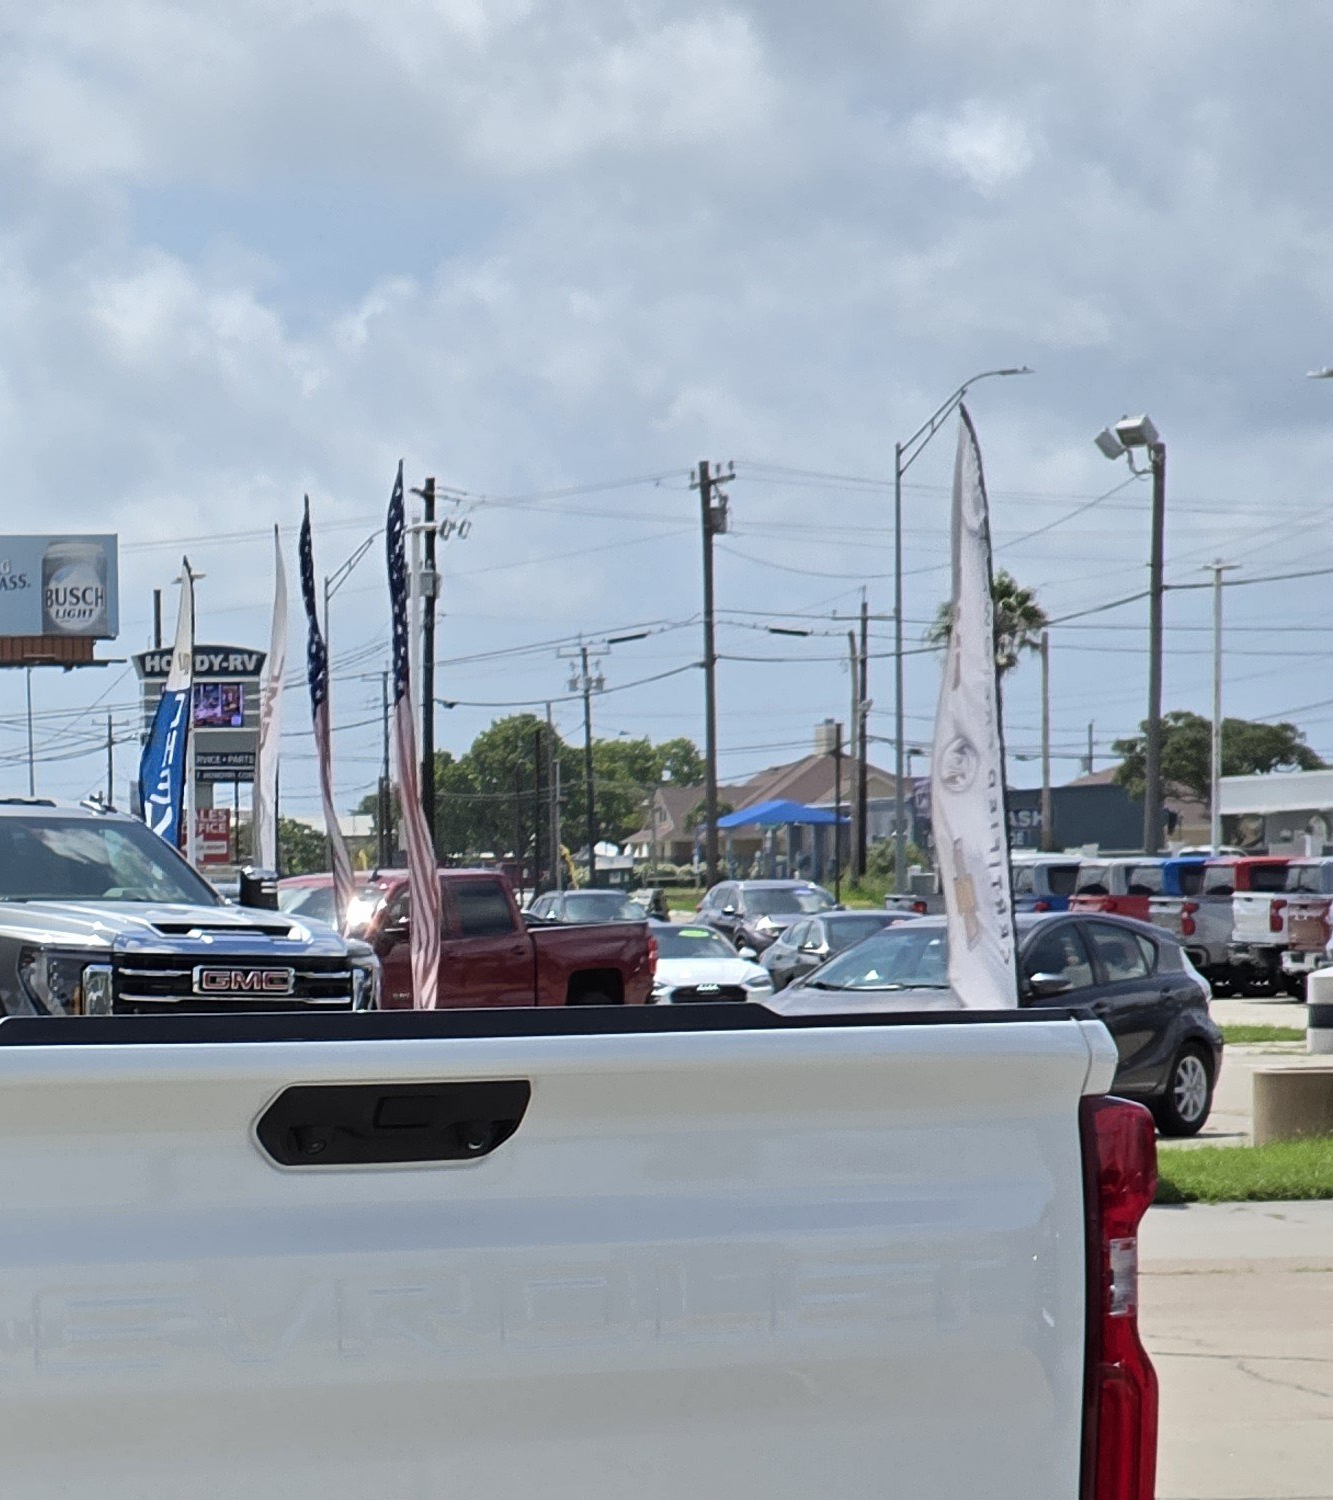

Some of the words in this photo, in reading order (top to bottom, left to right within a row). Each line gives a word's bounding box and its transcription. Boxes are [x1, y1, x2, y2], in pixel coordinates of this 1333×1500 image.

[45, 586, 104, 608] BUSCH
[55, 608, 94, 619] LIGHT
[144, 653, 258, 673] HODY-RV
[196, 754, 221, 764] RVICE
[1008, 810, 1045, 827] ASH
[202, 970, 290, 990] GMC
